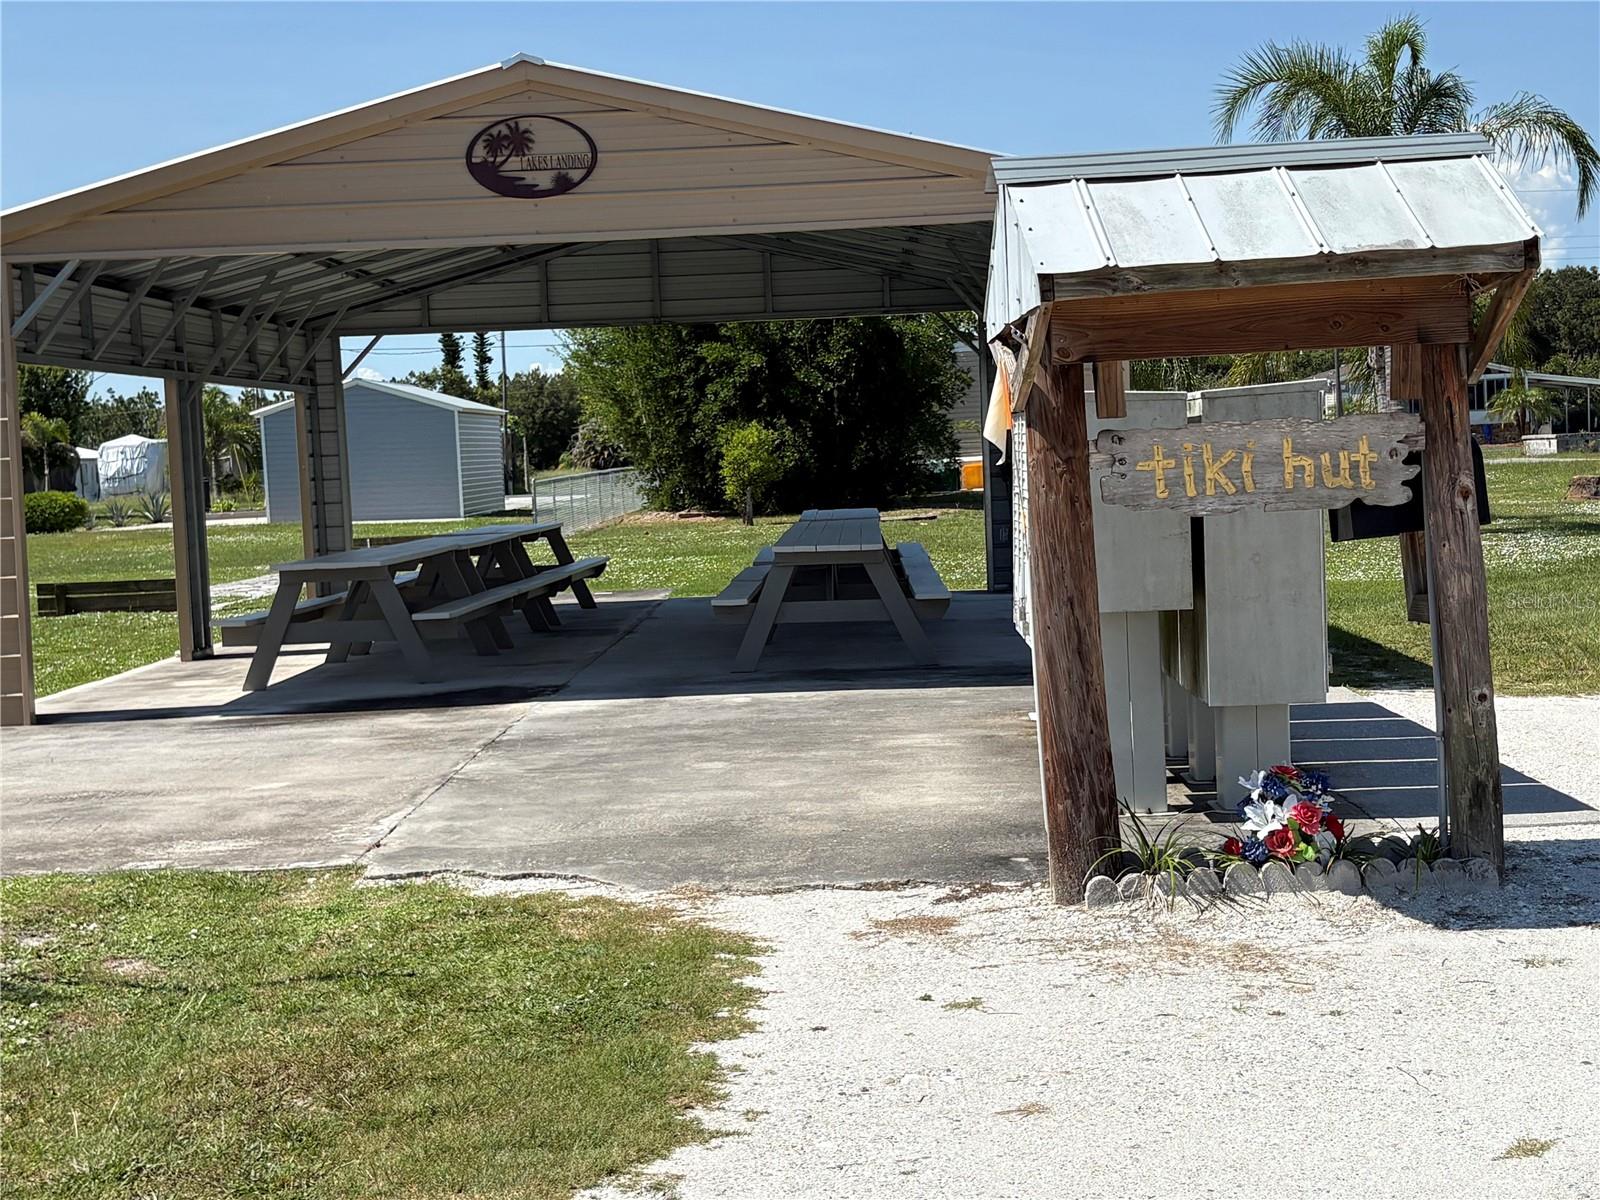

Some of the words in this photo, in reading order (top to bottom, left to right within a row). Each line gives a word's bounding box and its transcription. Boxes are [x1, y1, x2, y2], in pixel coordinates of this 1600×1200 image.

[520, 154, 549, 171] LAKES
[549, 154, 590, 170] LANDING
[1136, 442, 1256, 499] tiki
[1283, 435, 1377, 490] hut
